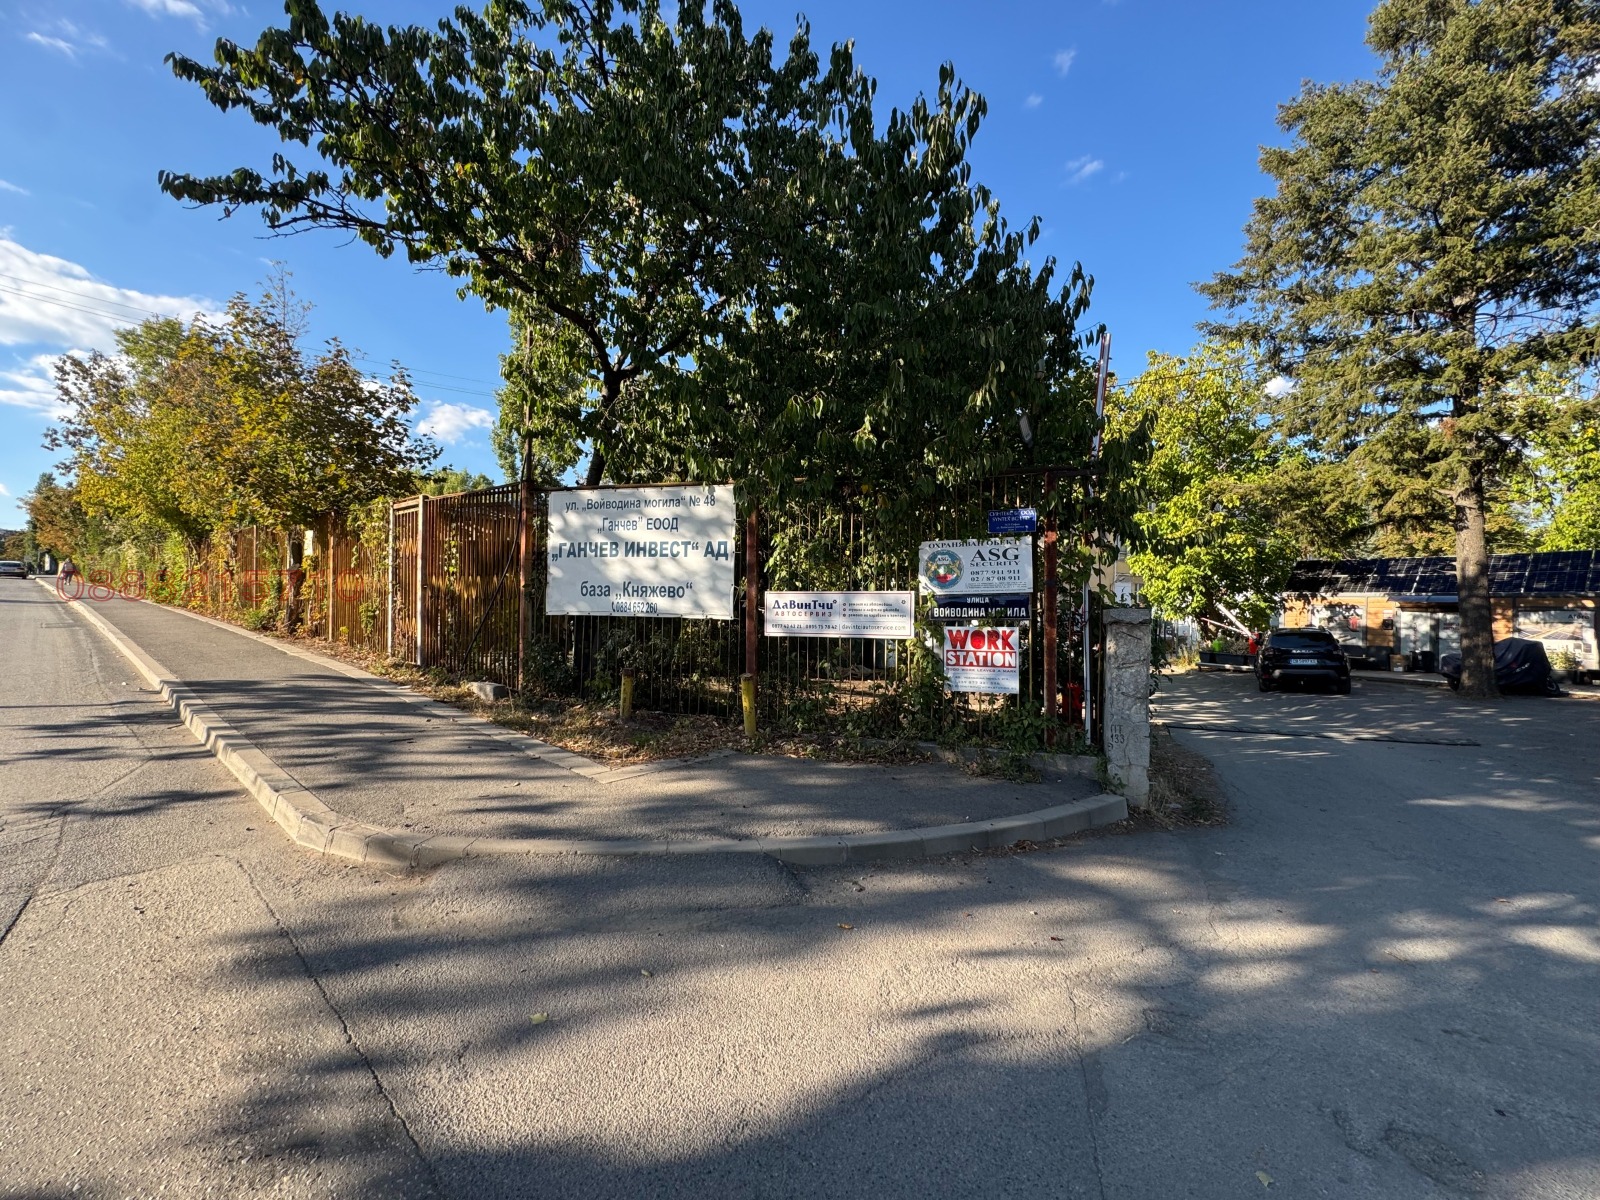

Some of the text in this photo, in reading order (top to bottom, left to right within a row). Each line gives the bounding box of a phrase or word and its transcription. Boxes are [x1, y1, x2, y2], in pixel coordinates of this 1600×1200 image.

[565, 494, 716, 513] ул. „Войводина могила“ № 48
[646, 517, 679, 532] ЕООД
[551, 540, 729, 561] „ГАНЧЕВ ИНВЕСТ“ АД
[971, 547, 1021, 562] ASG
[580, 581, 693, 600] база „Княжево“
[646, 602, 658, 614] 260
[933, 606, 1026, 617] ВОЙВОДИНА МИЛА
[947, 629, 1015, 650] WORK
[947, 651, 1016, 667] STATION
